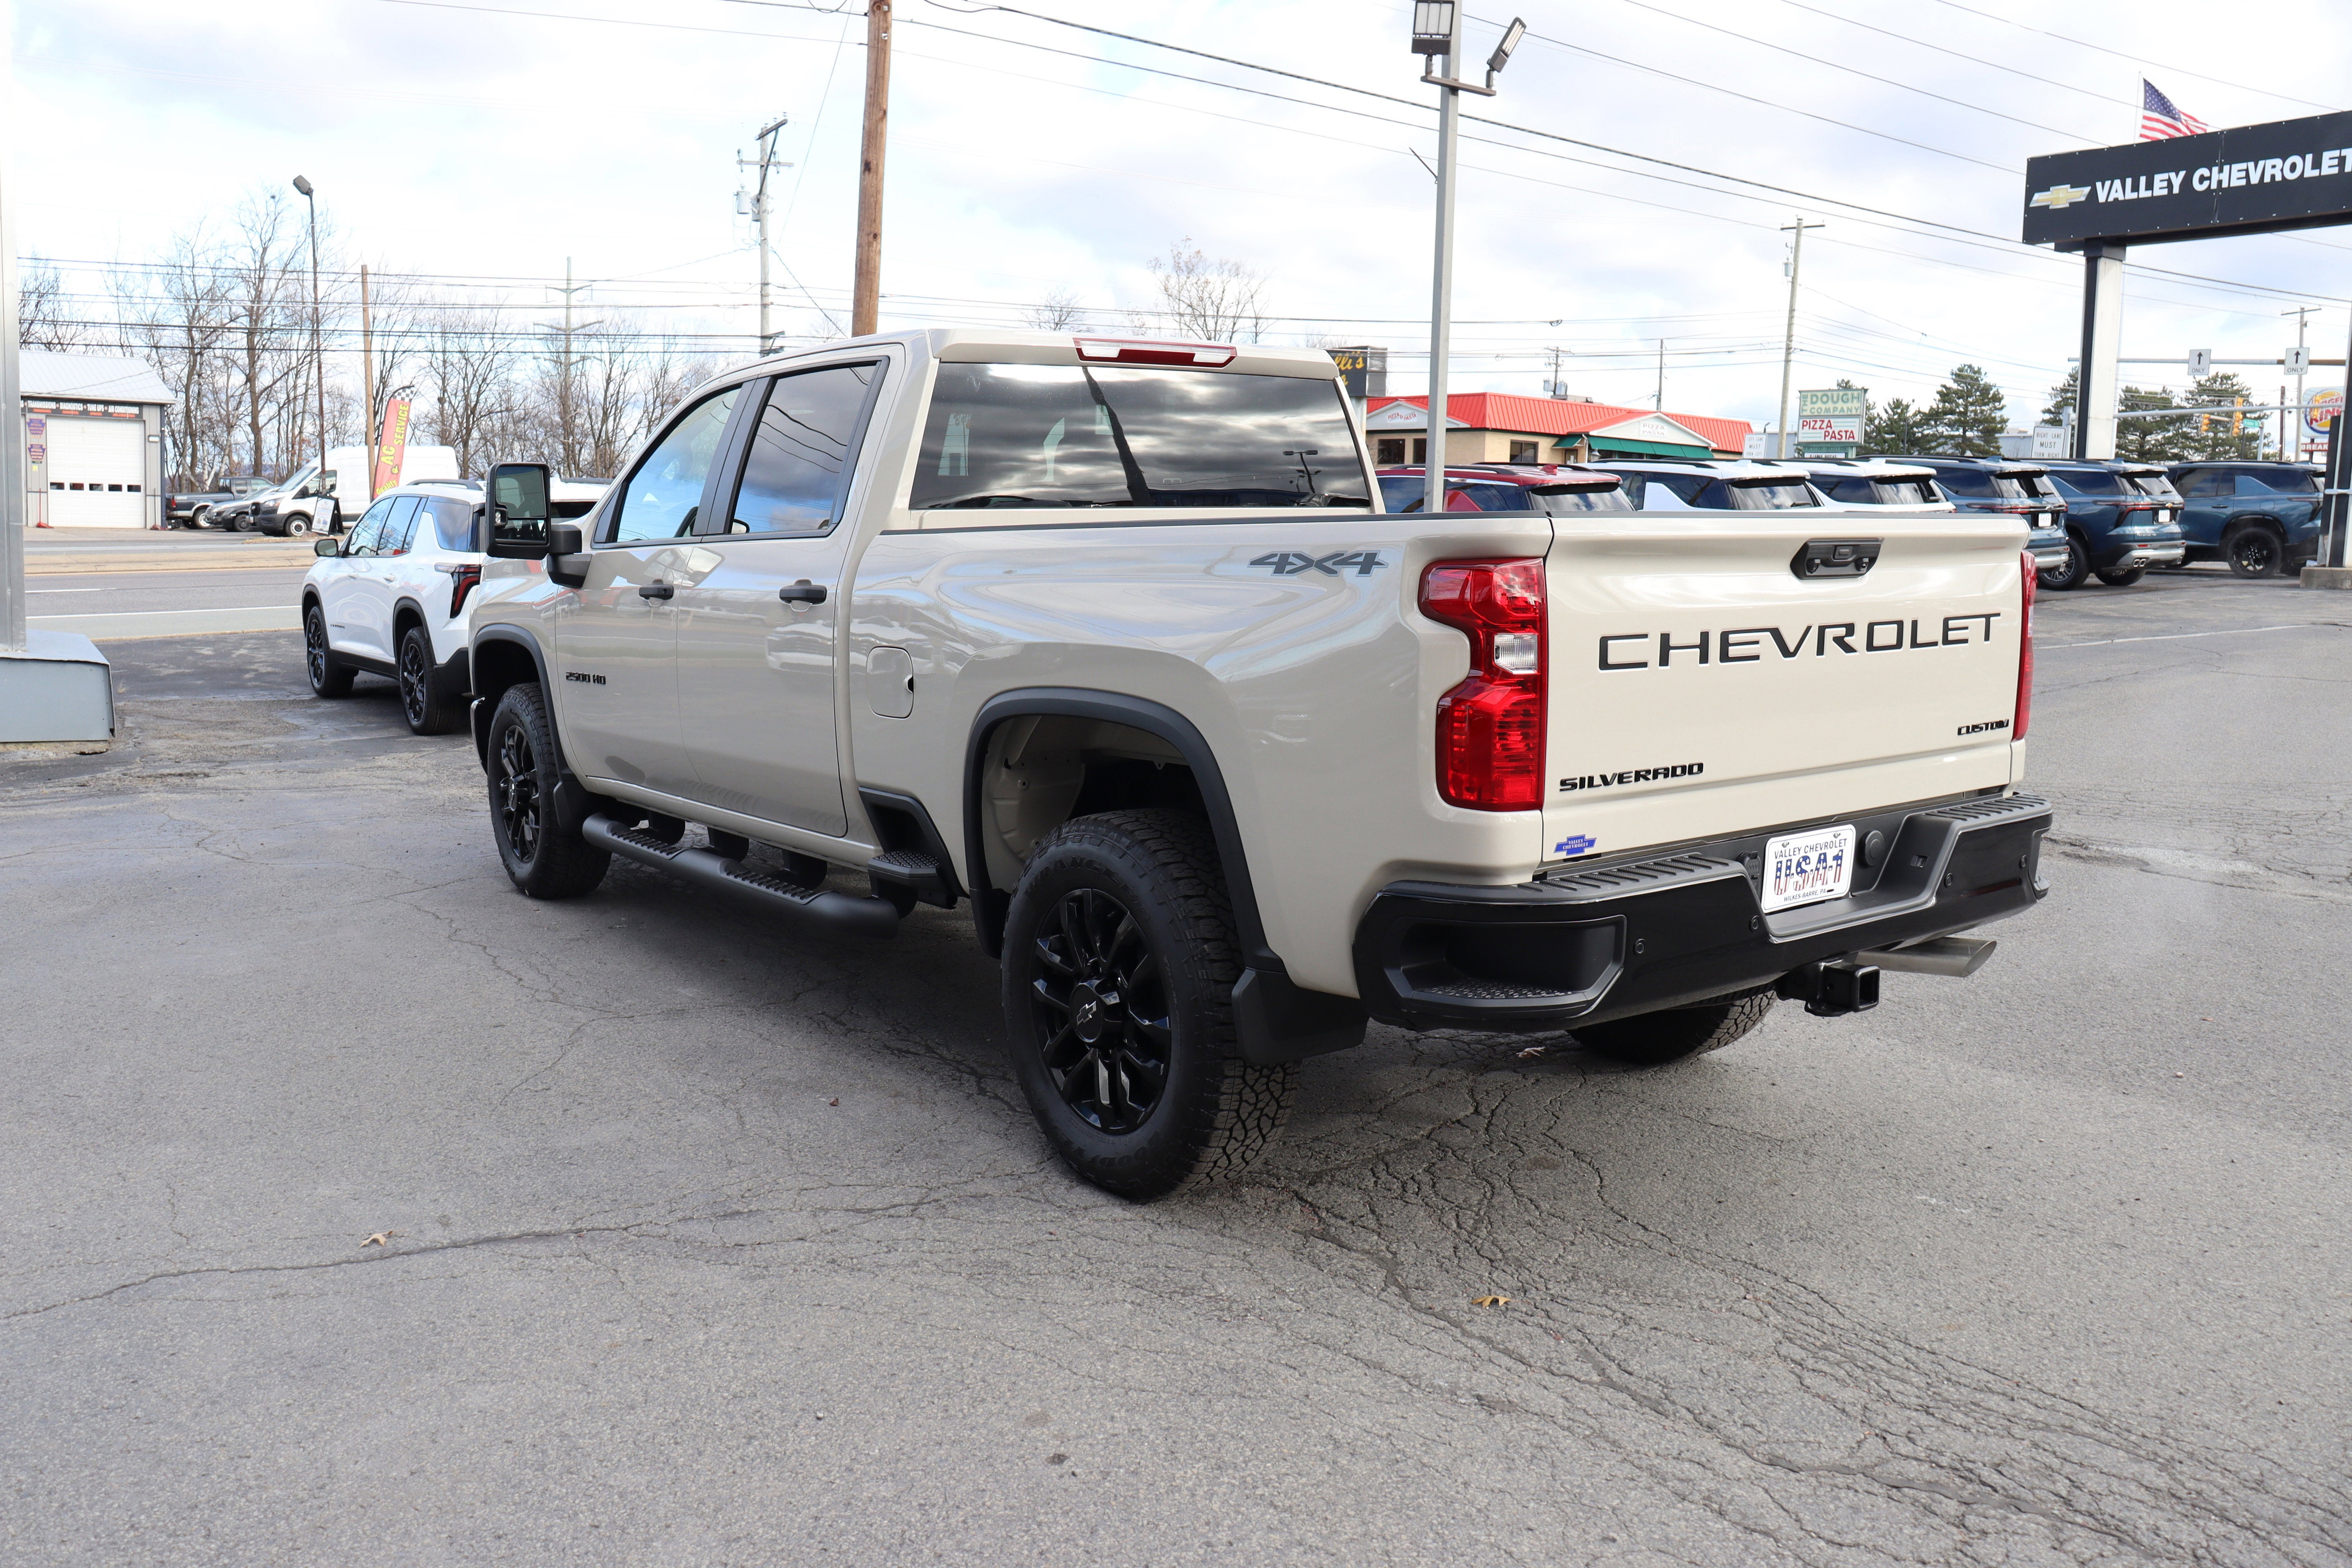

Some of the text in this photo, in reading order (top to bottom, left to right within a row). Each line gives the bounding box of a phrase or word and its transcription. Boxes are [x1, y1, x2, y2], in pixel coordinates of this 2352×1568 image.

[2096, 148, 2352, 203] VALLEY CHEVROLET
[1810, 392, 1860, 405] DOUGH
[27, 400, 56, 410] TRANSMISSIONS
[60, 402, 83, 411] DIAGNOSTICS
[87, 403, 97, 412] TUNE
[115, 405, 139, 414] CONDITIONING
[1809, 406, 1860, 414] COMPANY
[393, 403, 410, 445] SERVICE
[1388, 412, 1400, 420] PIZZA
[1403, 413, 1417, 421] PASTA
[1802, 419, 1833, 430] PIZZA
[1824, 430, 1855, 441] PASTA
[380, 444, 396, 466] AC
[376, 479, 398, 495] Quality
[1598, 612, 2001, 671] CHEVROLET
[566, 671, 606, 685] 2500 HD
[1957, 719, 2009, 736] CUSTOM
[1559, 762, 1704, 792] SILVERADO
[1774, 838, 1848, 860] VALLEY CHEVROLET
[1024, 855, 1152, 922] WRANGLER
[1784, 890, 1818, 902] WILKES-BARRE,
